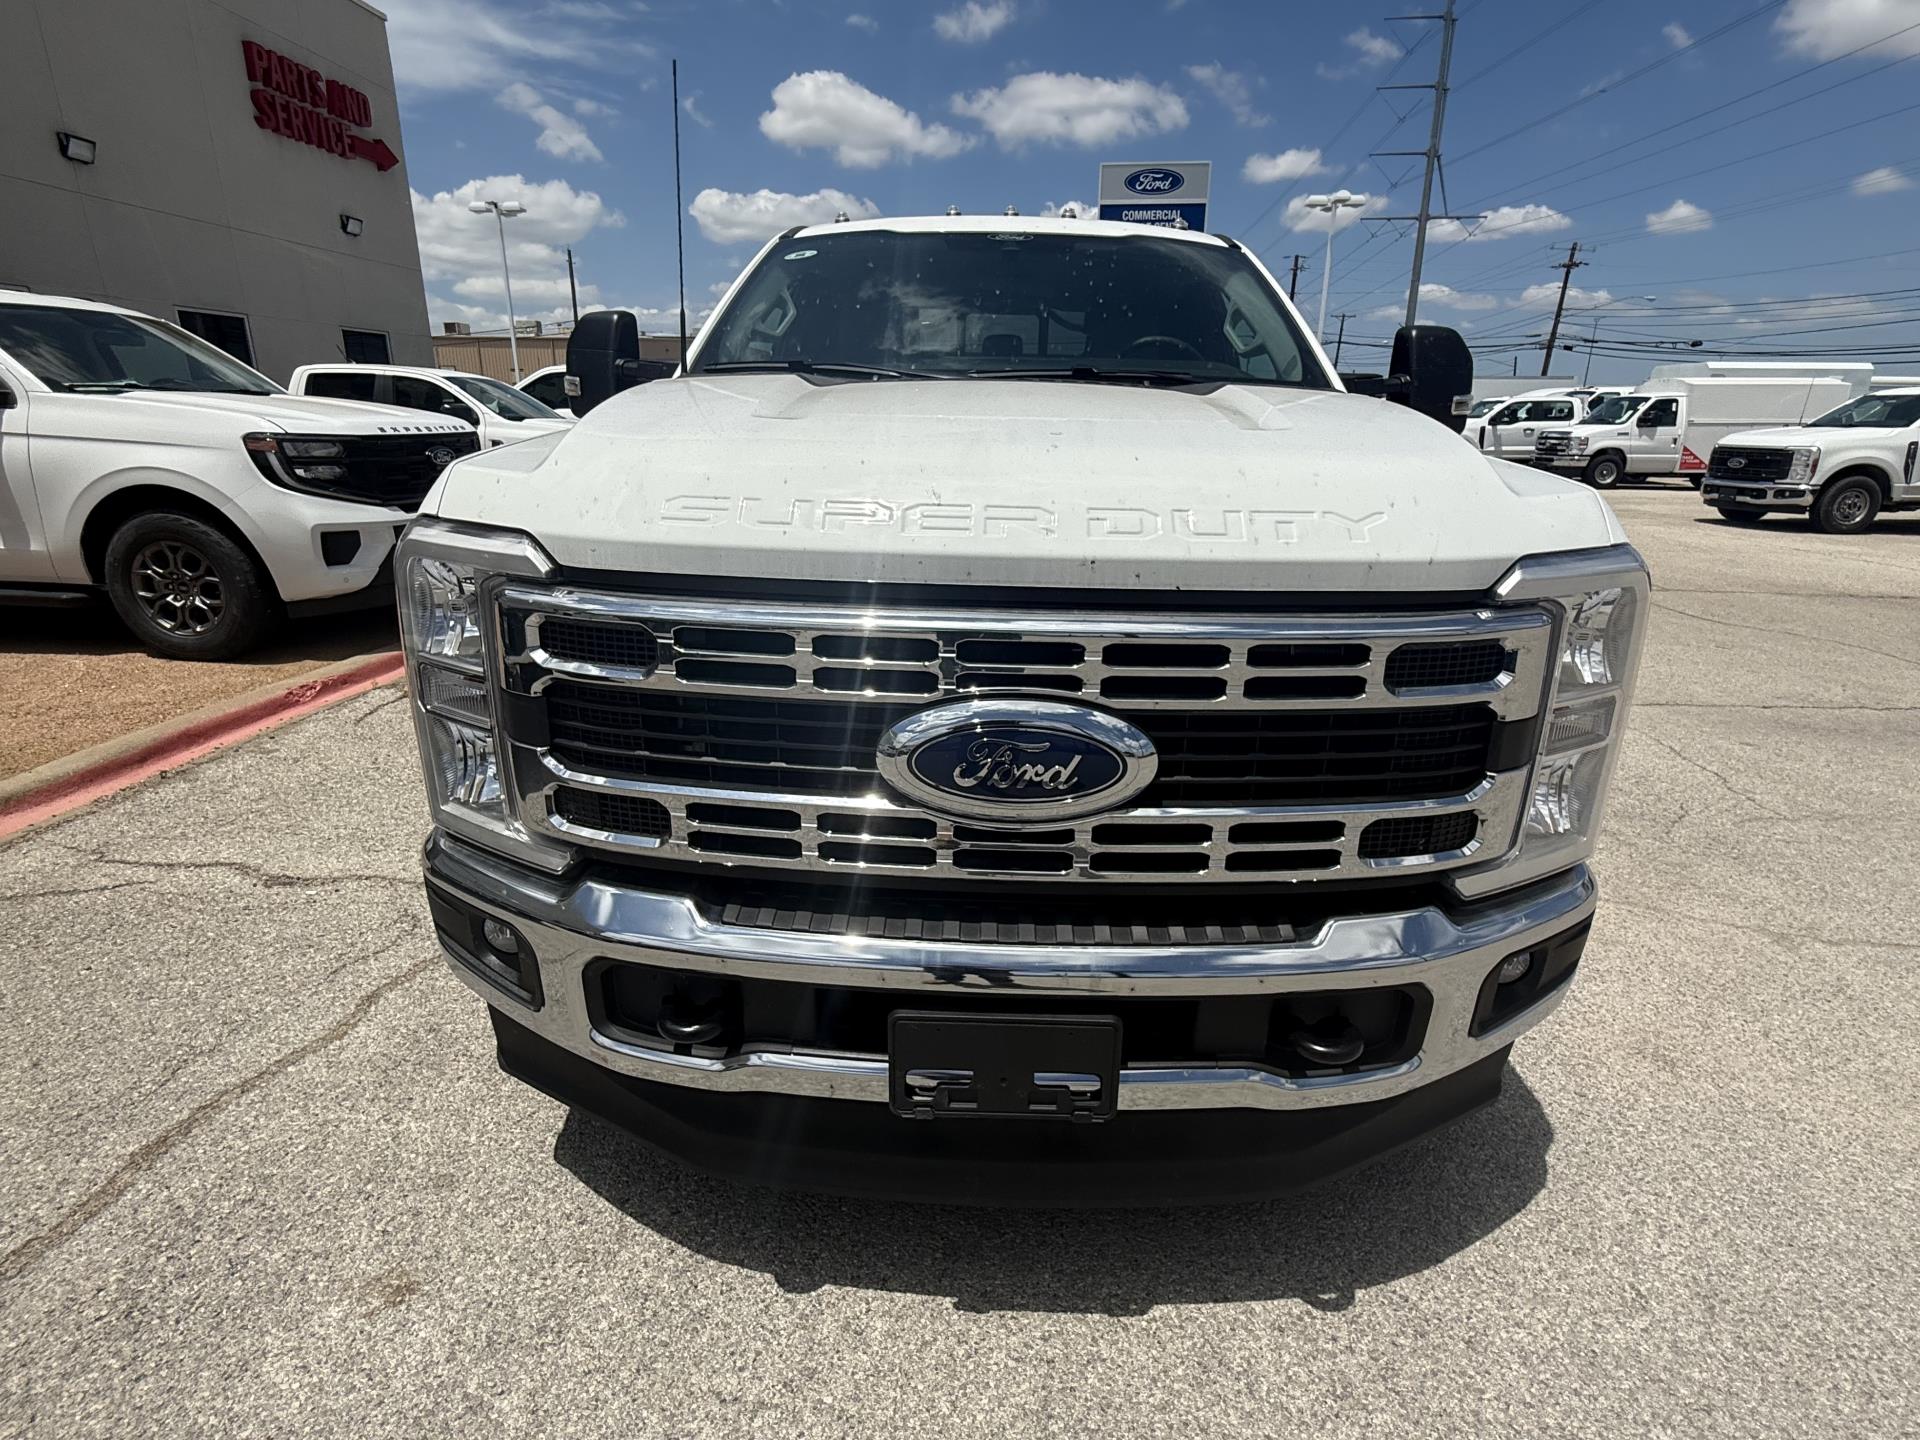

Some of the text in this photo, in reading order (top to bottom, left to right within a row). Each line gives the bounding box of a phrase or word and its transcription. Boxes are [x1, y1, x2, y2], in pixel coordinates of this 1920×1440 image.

[242, 40, 372, 128] PARTS AND
[251, 88, 356, 160] SERVICE
[1135, 173, 1173, 190] Ford
[1122, 209, 1181, 221] COMMERCIAL
[659, 494, 1388, 543] SUPER DUTY
[953, 738, 1082, 790] Ford
